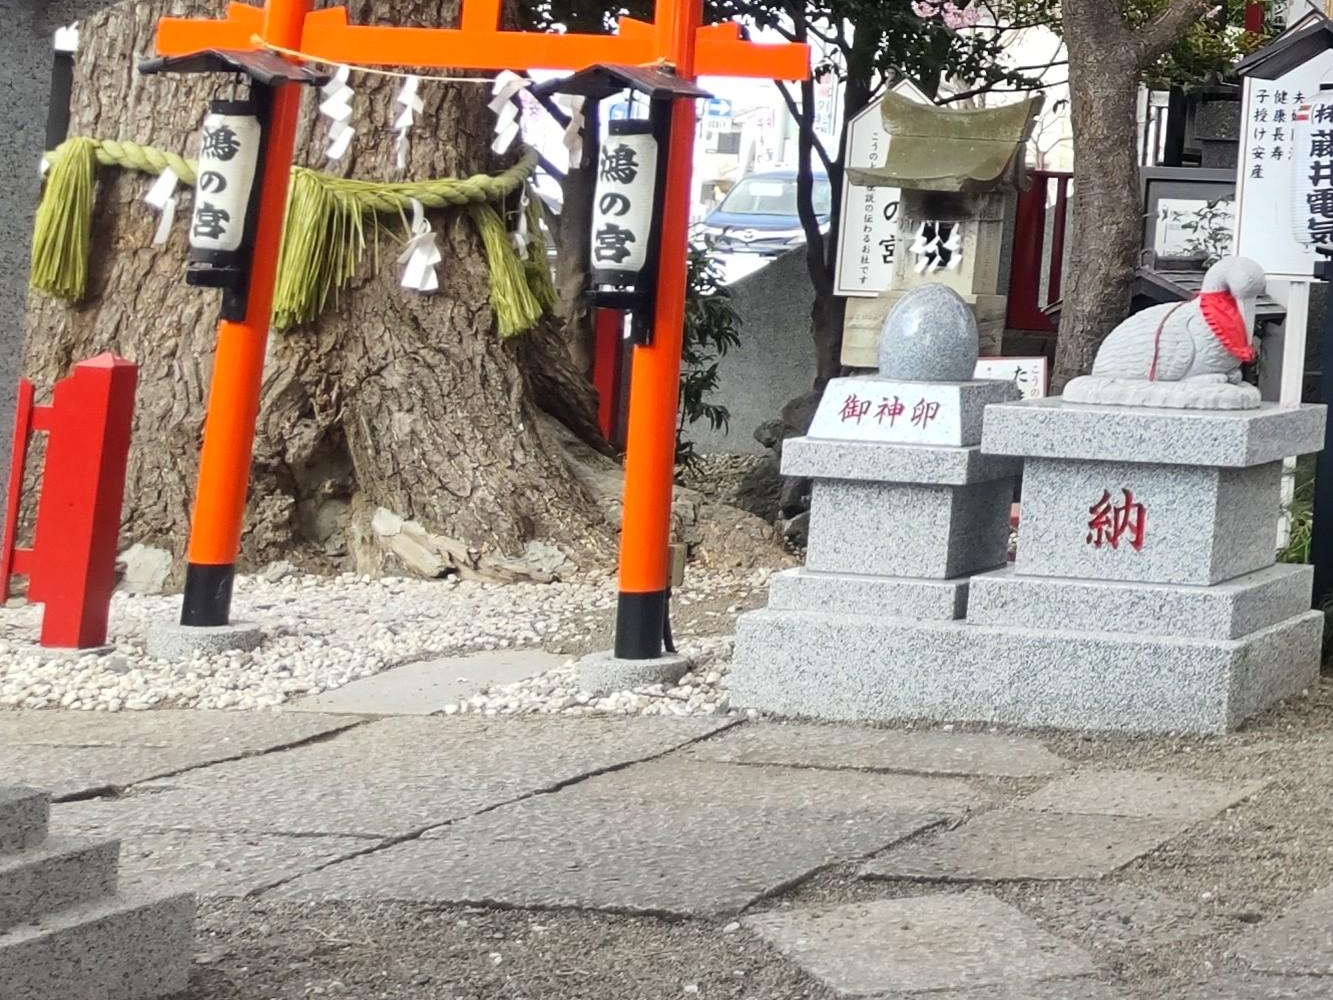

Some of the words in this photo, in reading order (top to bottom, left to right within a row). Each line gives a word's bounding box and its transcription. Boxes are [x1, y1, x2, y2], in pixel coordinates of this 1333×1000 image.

[1250, 89, 1271, 179] 子授け安産
[1271, 89, 1288, 161] 健康長寿
[193, 124, 242, 241] 鴻の宮
[594, 143, 640, 264] 鴻の宮
[838, 393, 941, 430] 御神卵
[1086, 488, 1148, 552] 納
